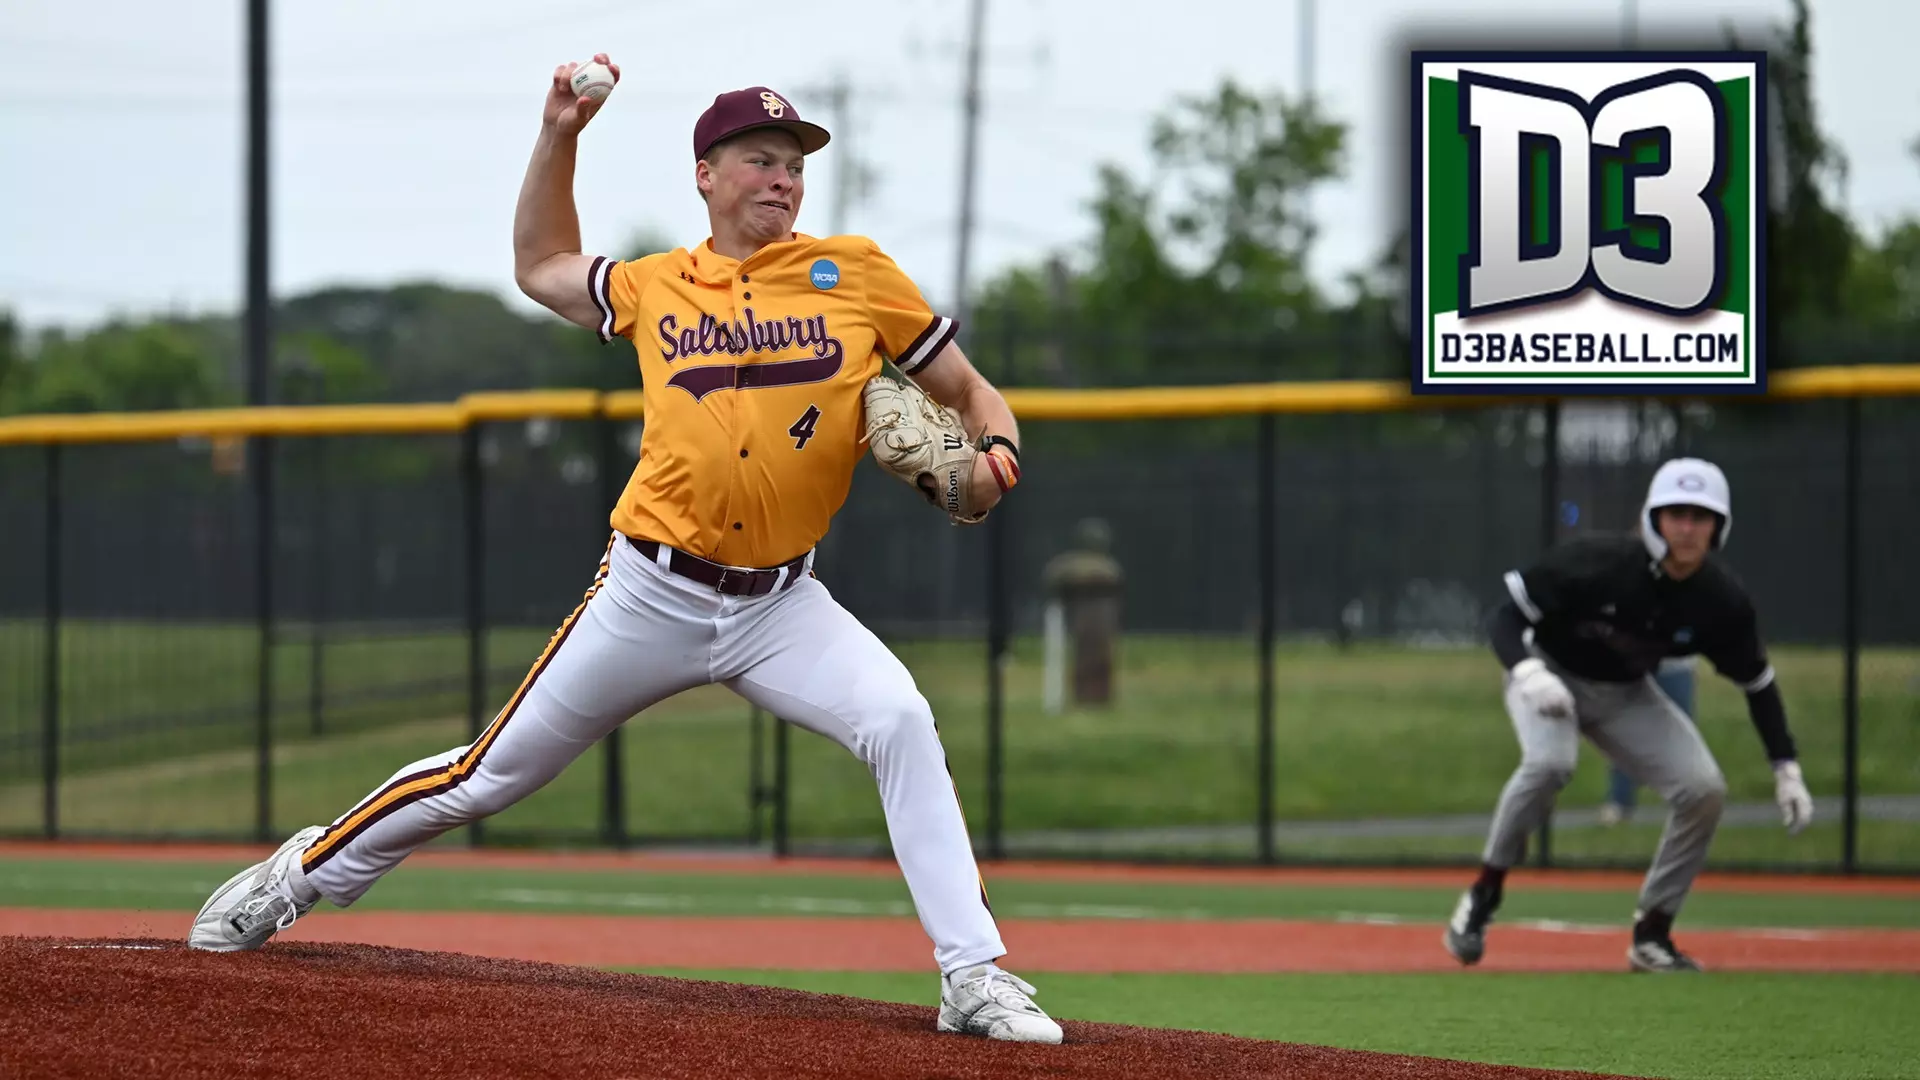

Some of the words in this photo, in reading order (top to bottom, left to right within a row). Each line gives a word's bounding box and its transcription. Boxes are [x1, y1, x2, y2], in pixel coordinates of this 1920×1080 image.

[813, 272, 838, 283] NCAA
[659, 307, 845, 364] Salisbury
[788, 404, 822, 450] 4
[947, 470, 960, 512] Wilson
